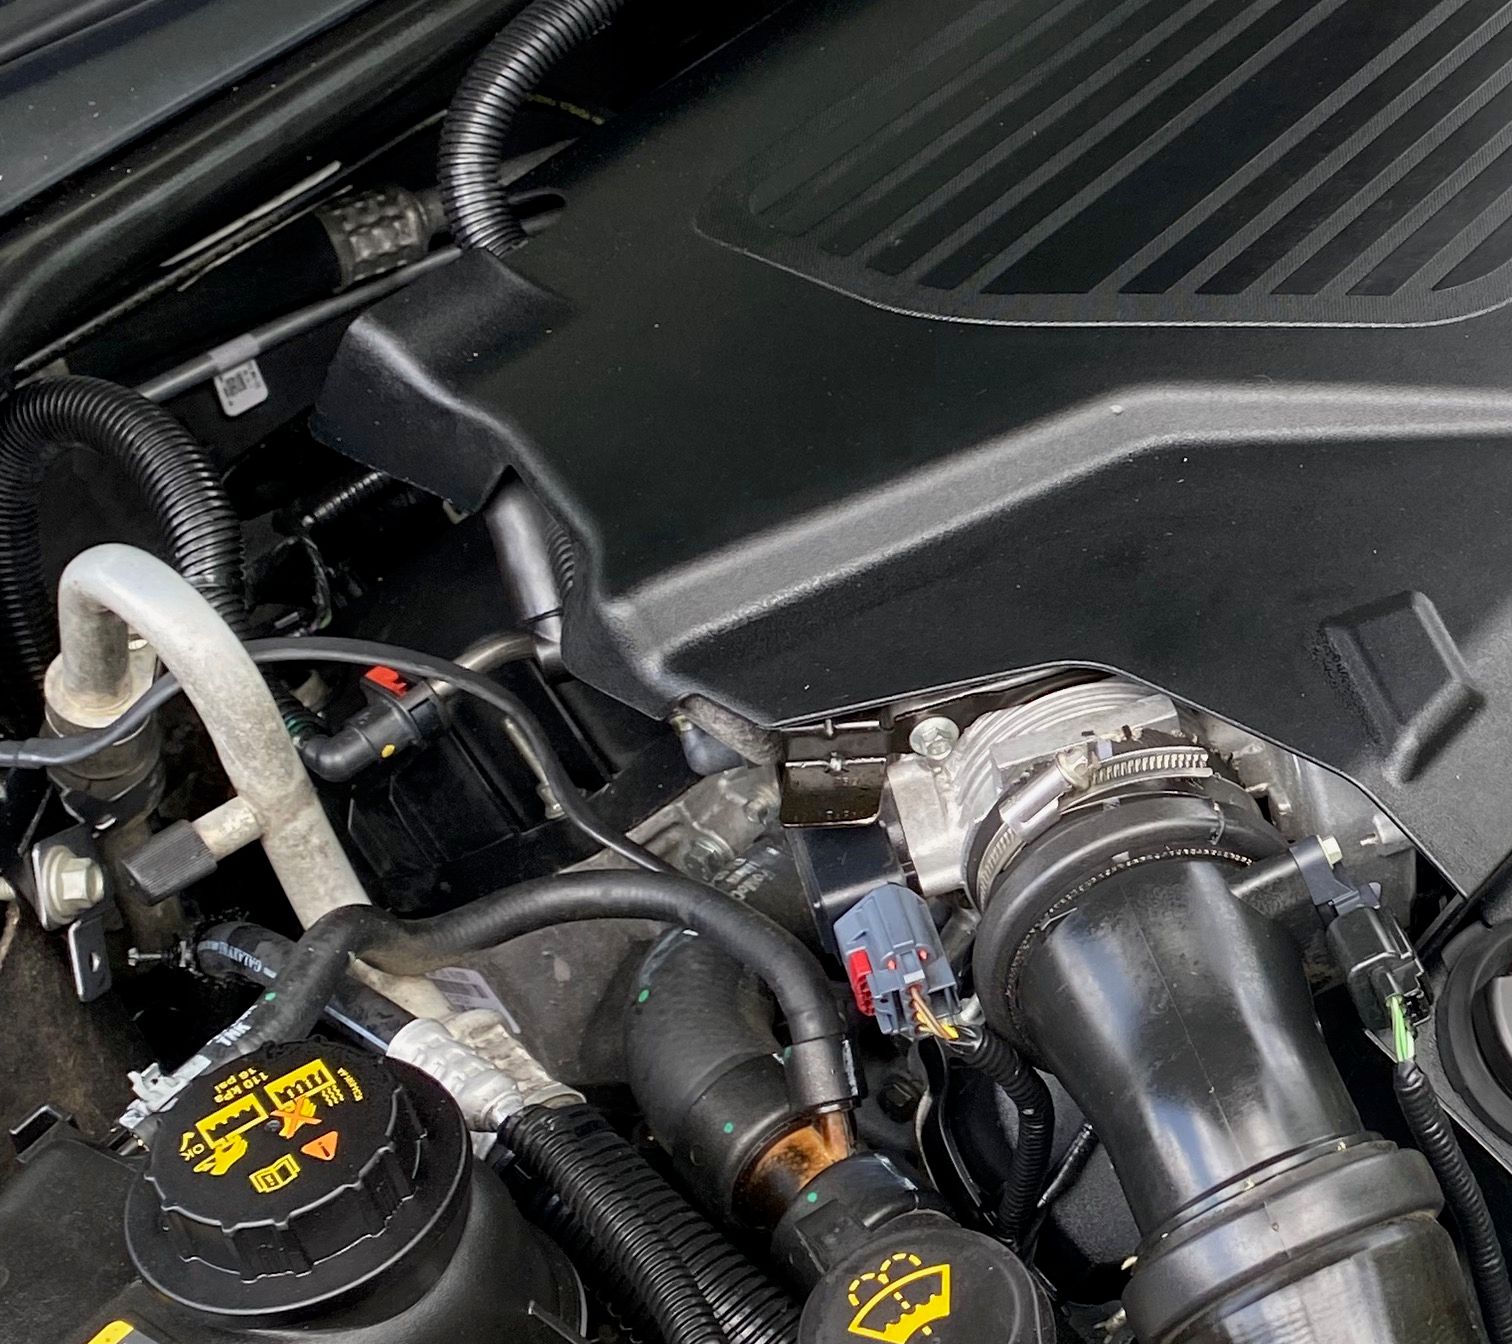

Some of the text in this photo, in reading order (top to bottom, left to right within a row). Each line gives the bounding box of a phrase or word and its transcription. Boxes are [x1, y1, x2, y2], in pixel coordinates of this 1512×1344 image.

[213, 1068, 257, 1092] 16 psi
[244, 1072, 269, 1089] 110
[179, 1143, 206, 1161] OK
